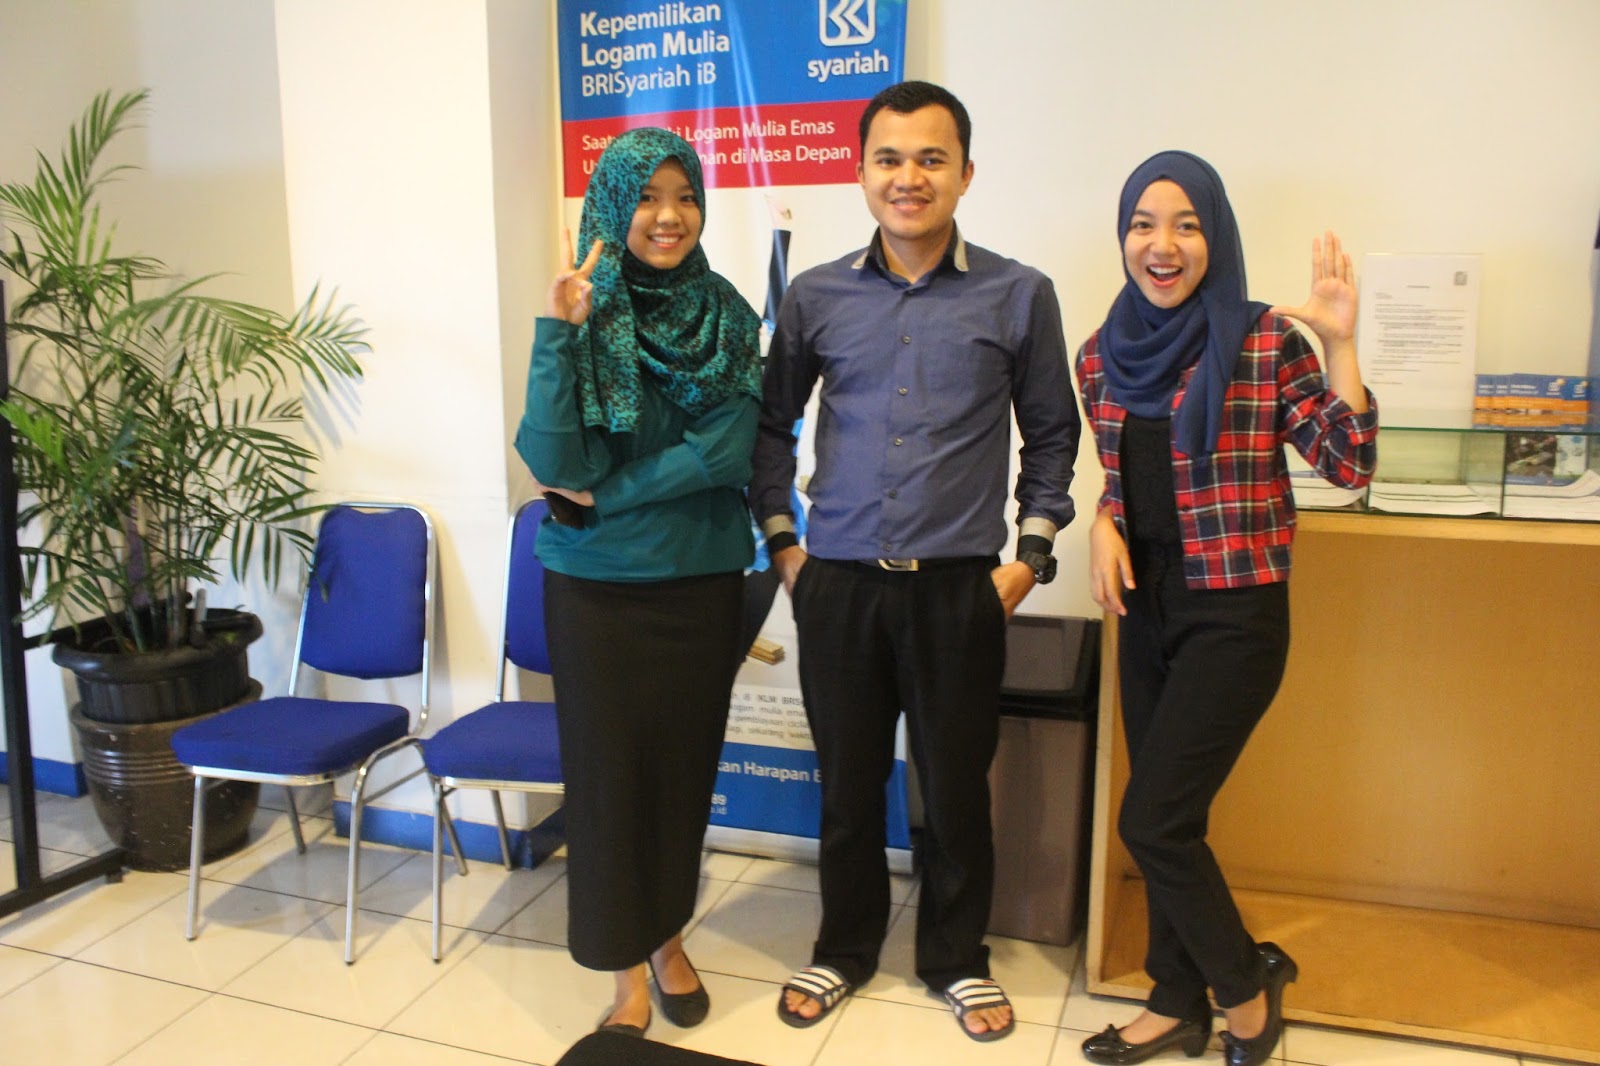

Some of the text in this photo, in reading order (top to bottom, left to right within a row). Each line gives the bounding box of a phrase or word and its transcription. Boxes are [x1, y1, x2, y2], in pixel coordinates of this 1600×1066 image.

[580, 1, 721, 39] Kepemilikan
[581, 30, 730, 69] Logam Mulia
[807, 48, 889, 83] syariah
[582, 61, 717, 98] BRISyariah iB
[685, 125, 739, 144] Logam
[743, 119, 786, 138] Mulia
[791, 119, 836, 136] Emas
[730, 147, 746, 164] di
[749, 146, 792, 163] Masa
[795, 145, 852, 164] Depan
[743, 761, 810, 782] Harapan
